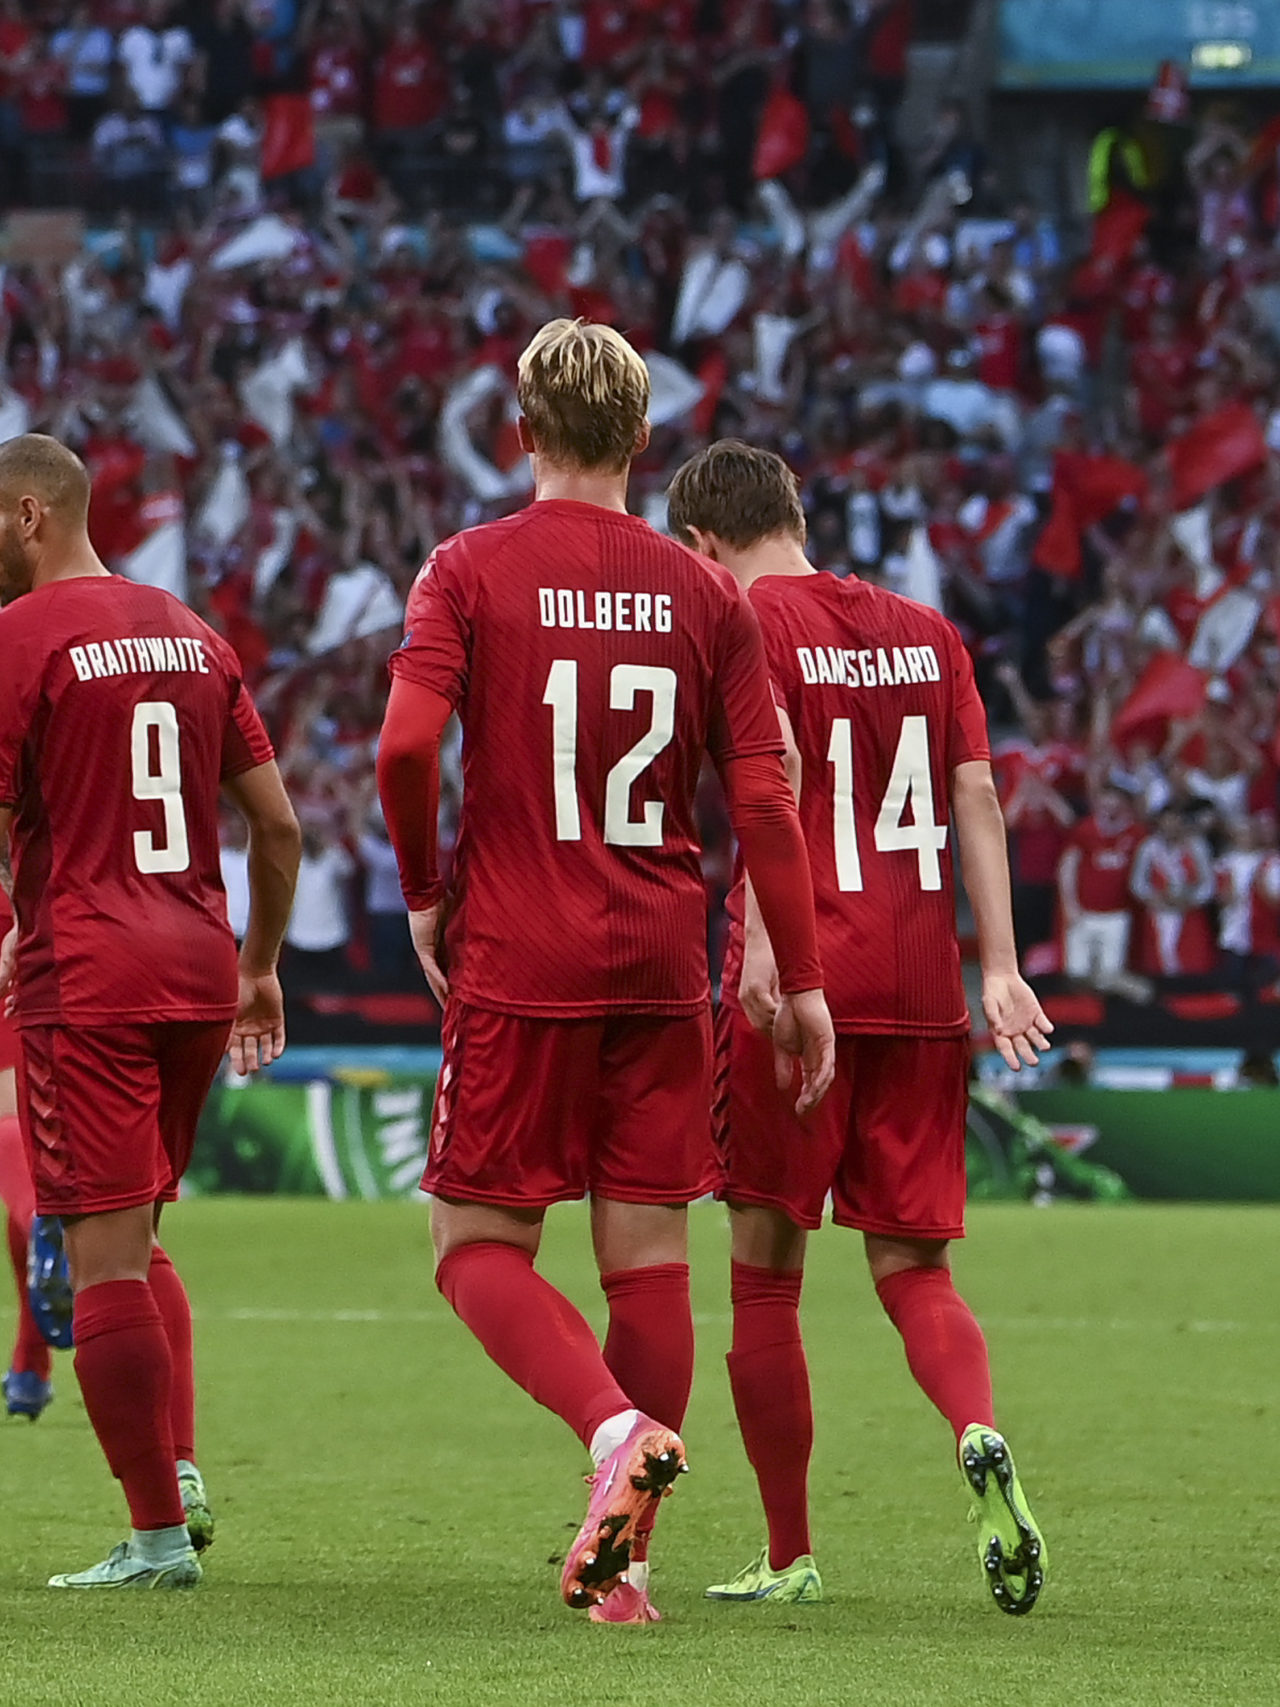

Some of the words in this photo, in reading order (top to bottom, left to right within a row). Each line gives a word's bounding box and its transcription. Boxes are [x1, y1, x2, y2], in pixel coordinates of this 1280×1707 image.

[69, 637, 211, 683] BRAITHWAITE
[538, 587, 673, 634] DOLBERG
[130, 701, 191, 876] 9
[542, 659, 678, 848] 12
[826, 715, 948, 893] 14
